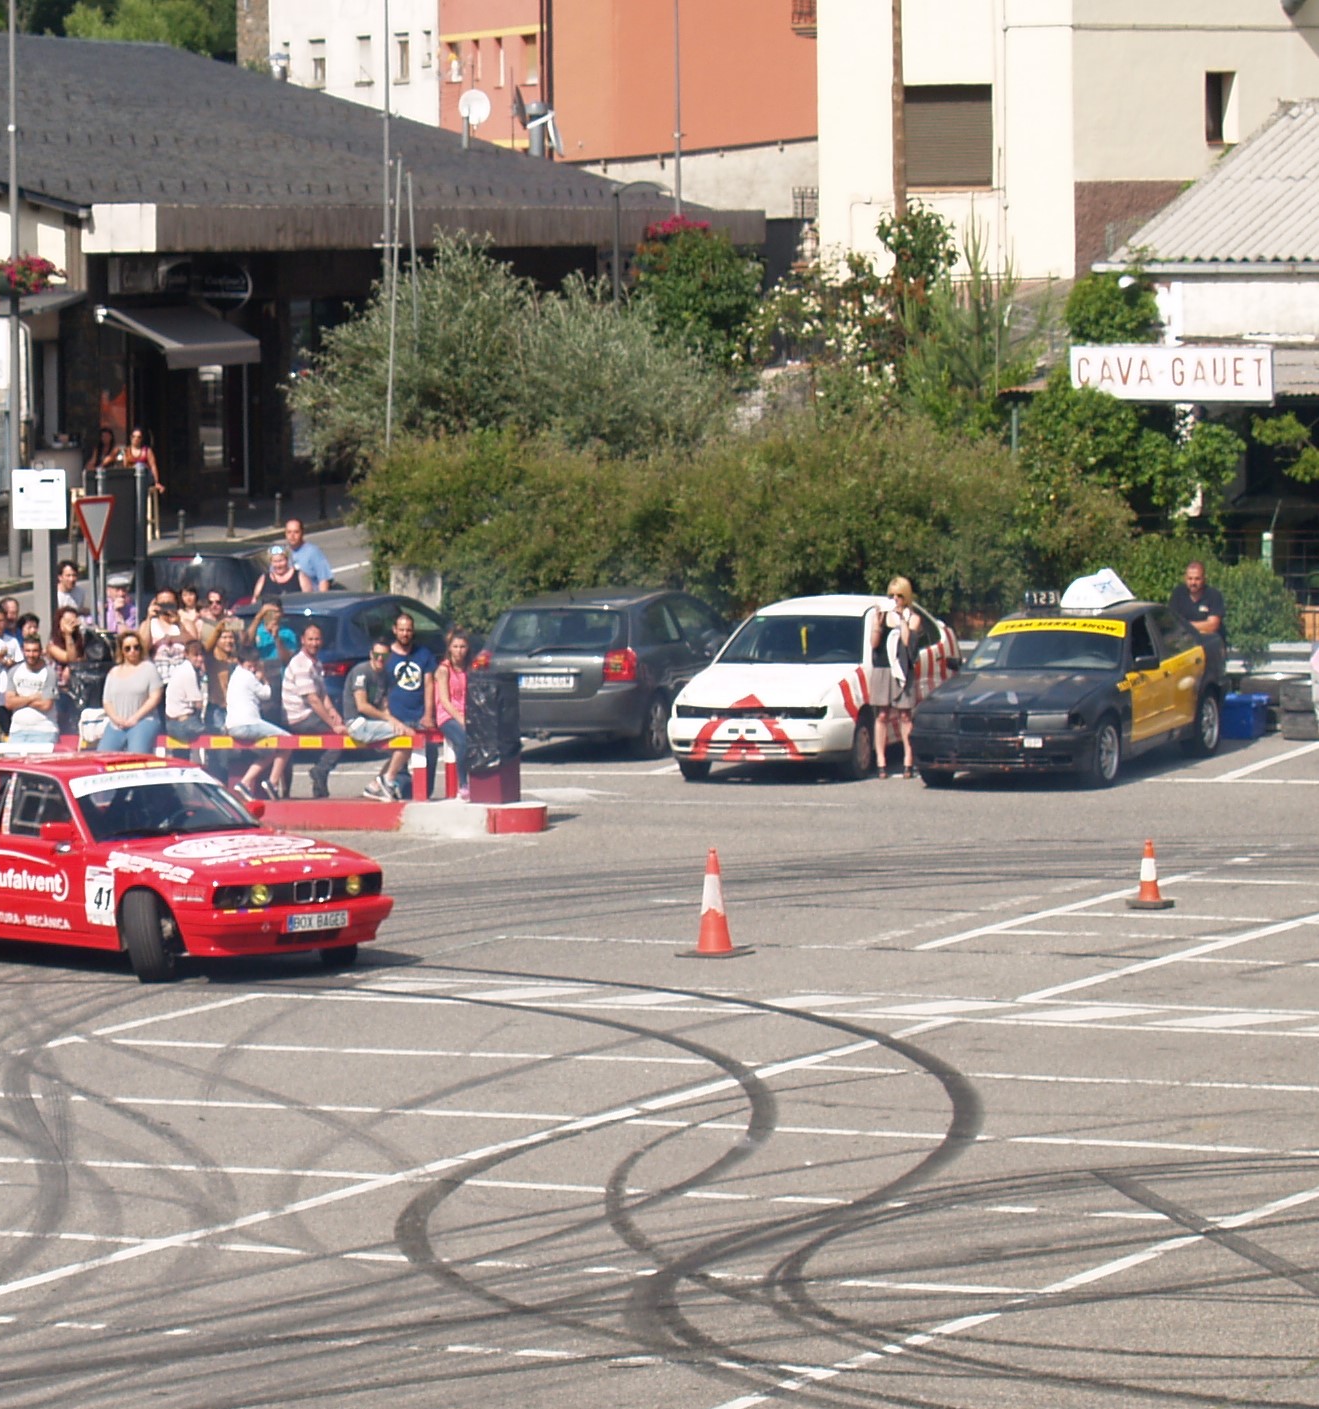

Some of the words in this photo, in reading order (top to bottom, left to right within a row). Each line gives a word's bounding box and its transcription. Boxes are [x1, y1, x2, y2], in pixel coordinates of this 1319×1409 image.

[1077, 357, 1153, 386] CAVA
[1171, 357, 1265, 387] GAUET
[1004, 622, 1033, 630] TEAM
[1082, 623, 1117, 631] SHOW
[94, 887, 113, 911] 41
[293, 915, 313, 929] BOX
